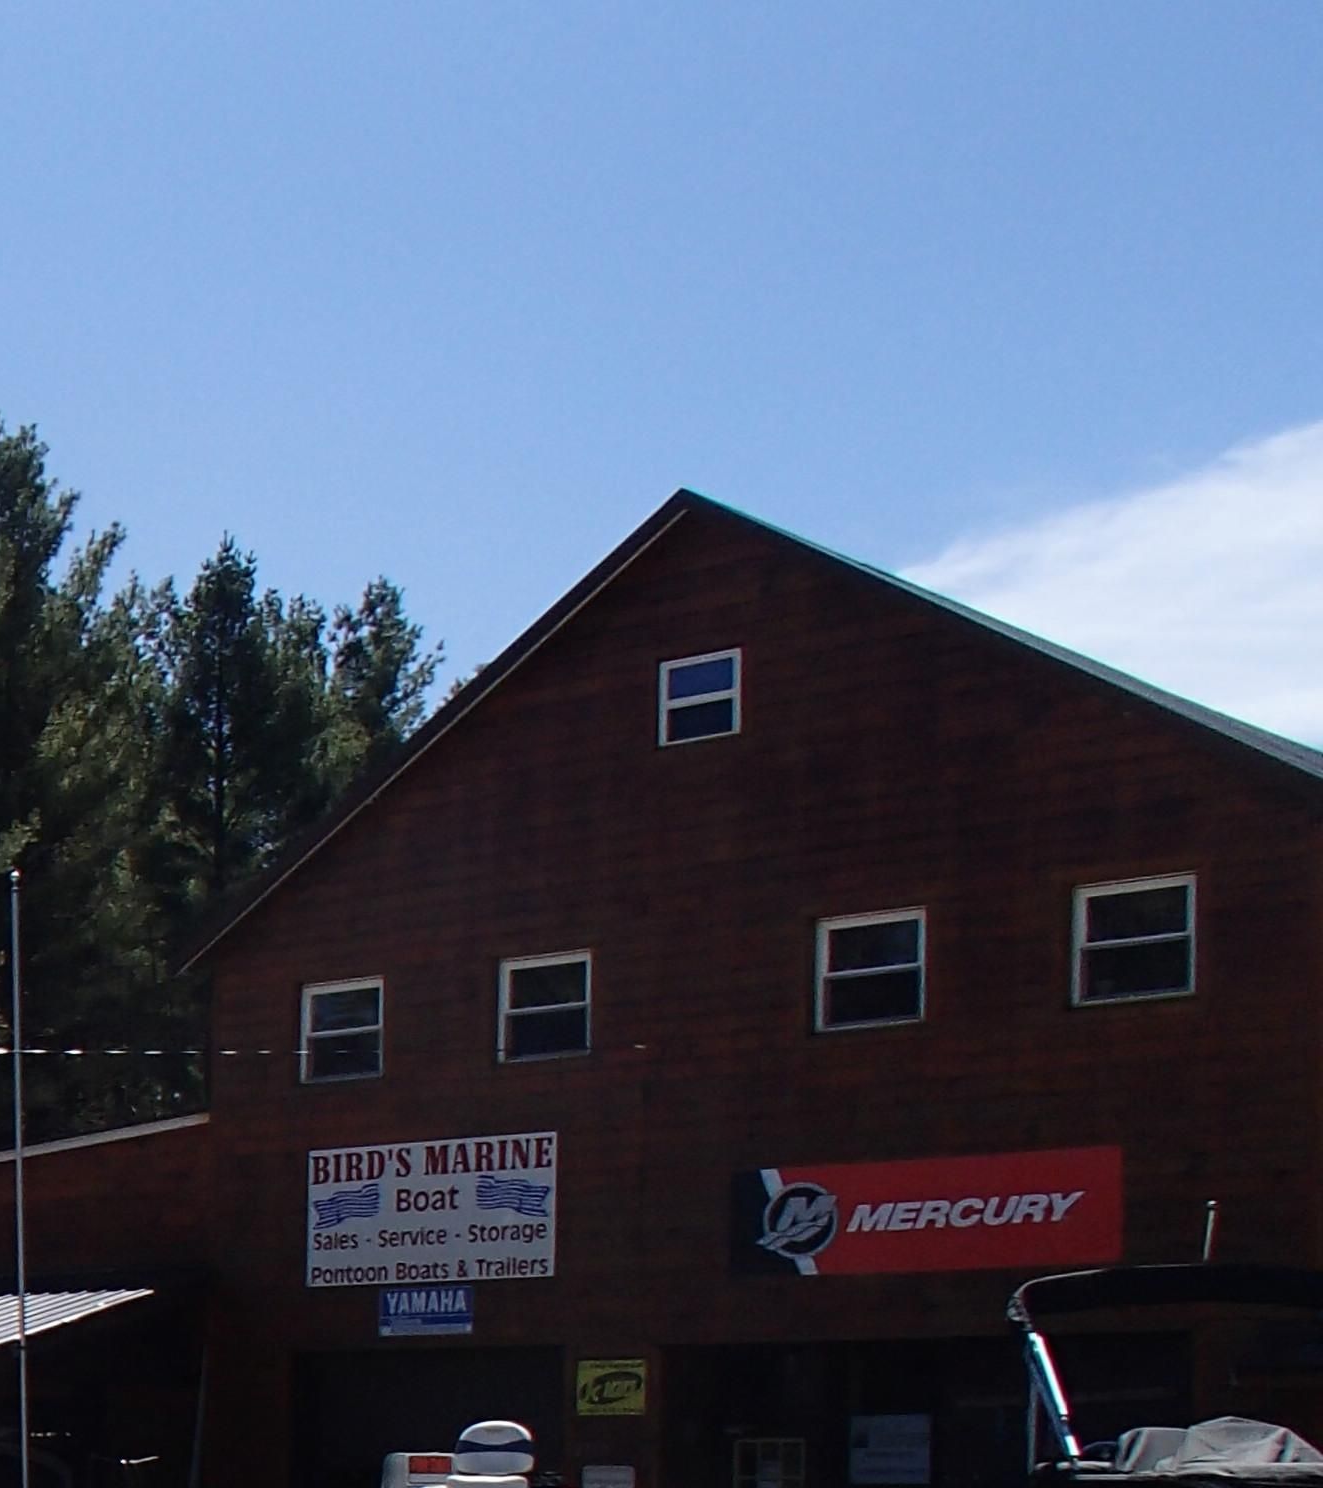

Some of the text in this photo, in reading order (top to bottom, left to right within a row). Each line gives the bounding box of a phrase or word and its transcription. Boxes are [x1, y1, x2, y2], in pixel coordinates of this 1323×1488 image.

[311, 1136, 553, 1186] BIRD'S MARINE
[395, 1185, 460, 1213] Boat
[846, 1190, 1086, 1233] MERCURY
[312, 1231, 360, 1251] Sales
[378, 1227, 448, 1248] Service
[468, 1222, 549, 1244] Storage
[311, 1257, 549, 1285] Pontoon Boats & Trailers
[386, 1289, 468, 1315] YAMAHA
